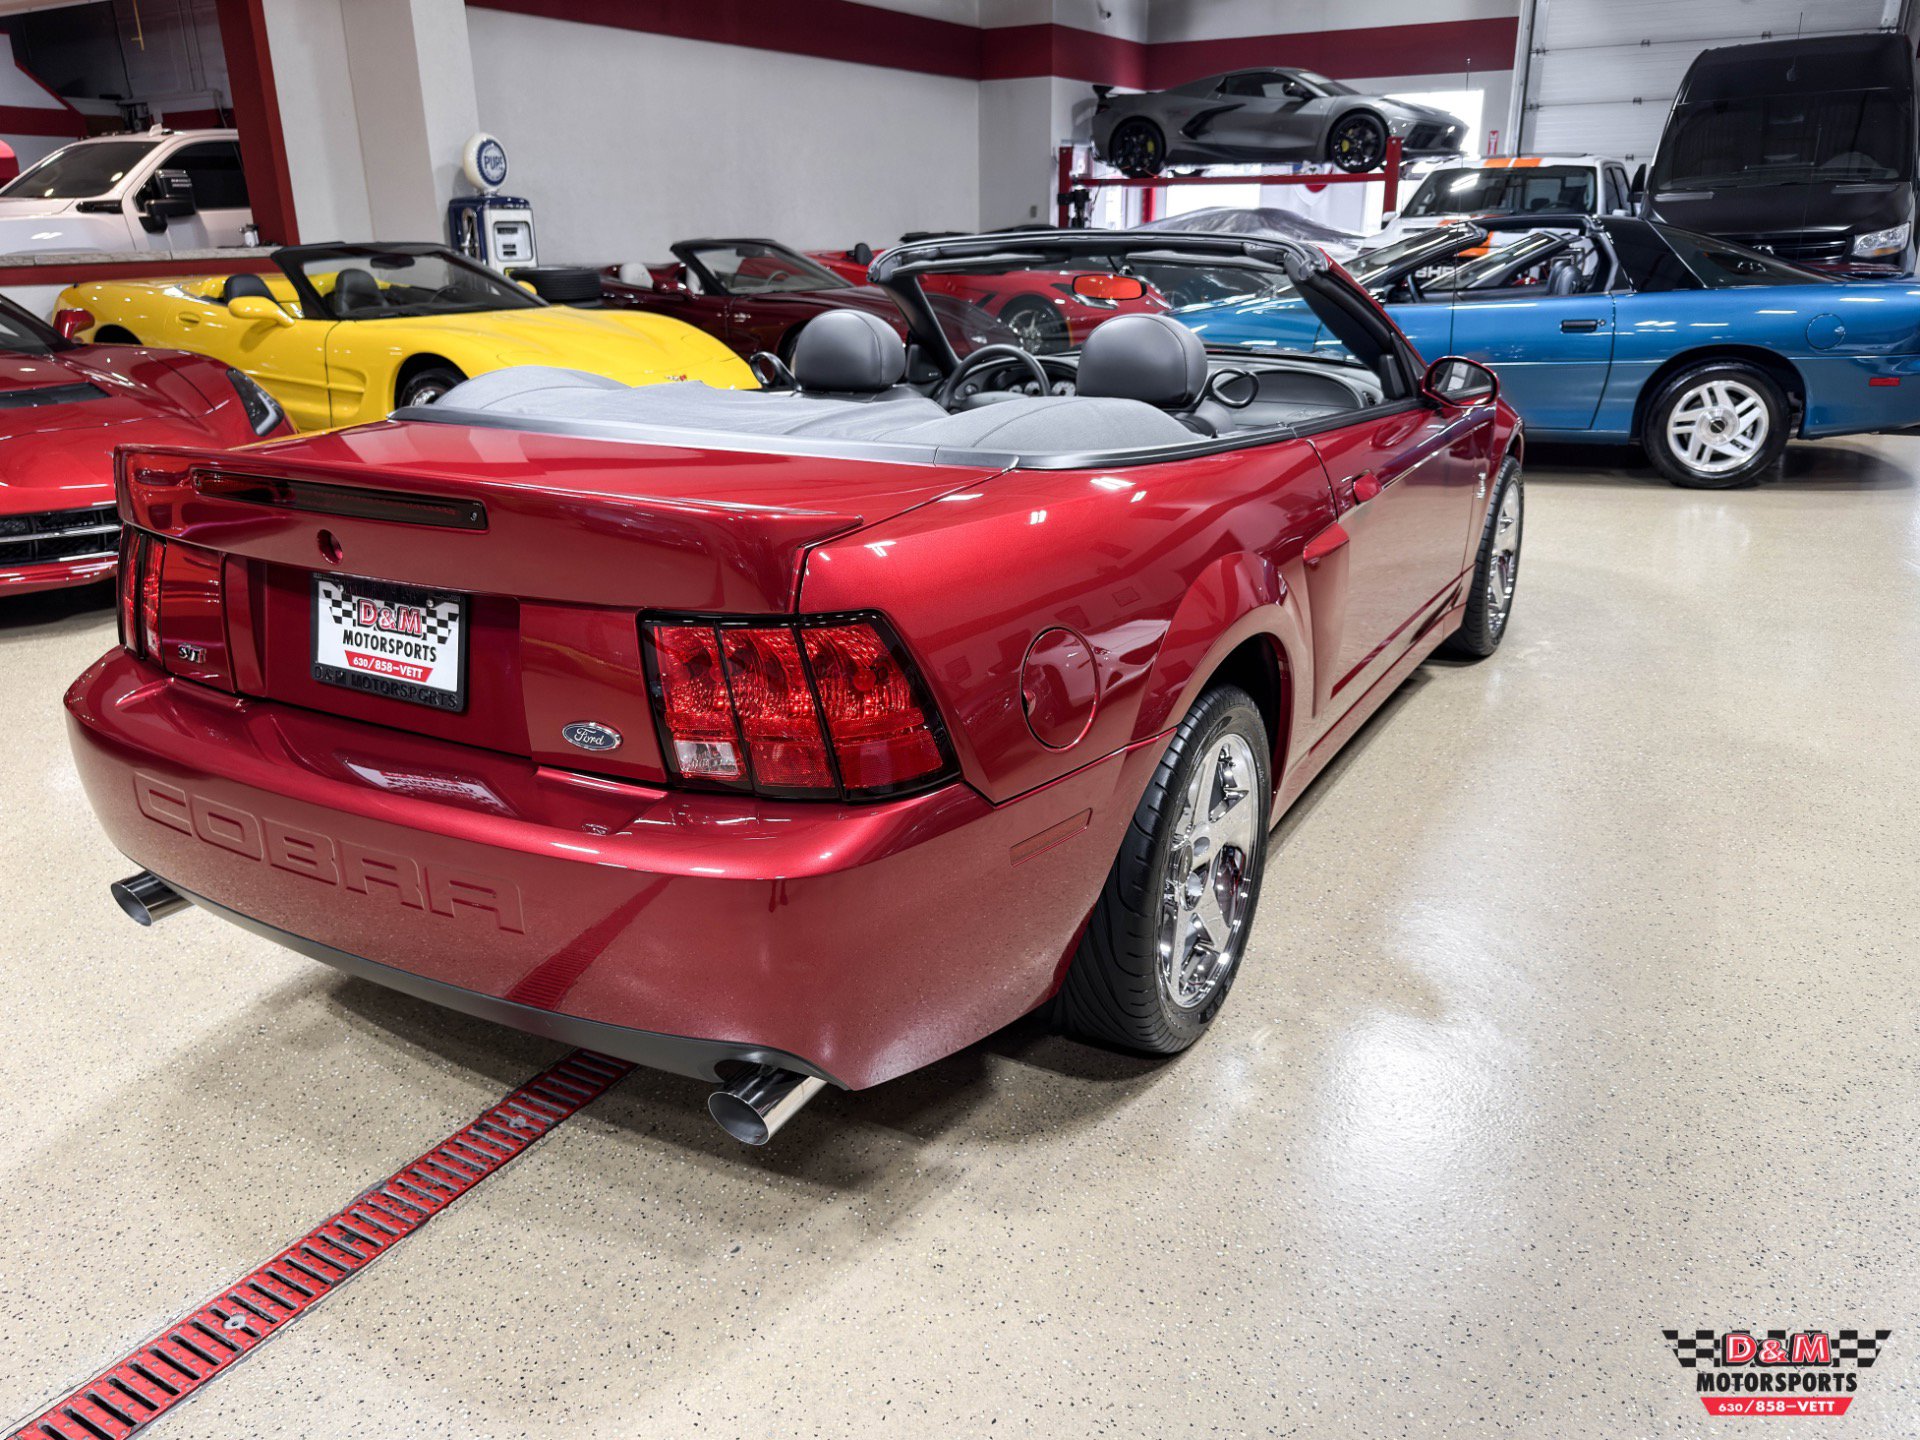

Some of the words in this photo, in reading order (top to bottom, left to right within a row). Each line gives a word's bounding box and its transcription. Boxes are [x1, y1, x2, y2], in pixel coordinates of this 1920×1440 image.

[358, 598, 424, 637] D&M
[343, 629, 437, 662] MOTORSPORTS
[353, 656, 423, 679] 630/858-VETT
[351, 673, 457, 708] MOTORSPORTS
[574, 727, 605, 746] Ford
[134, 771, 526, 935] COBRA
